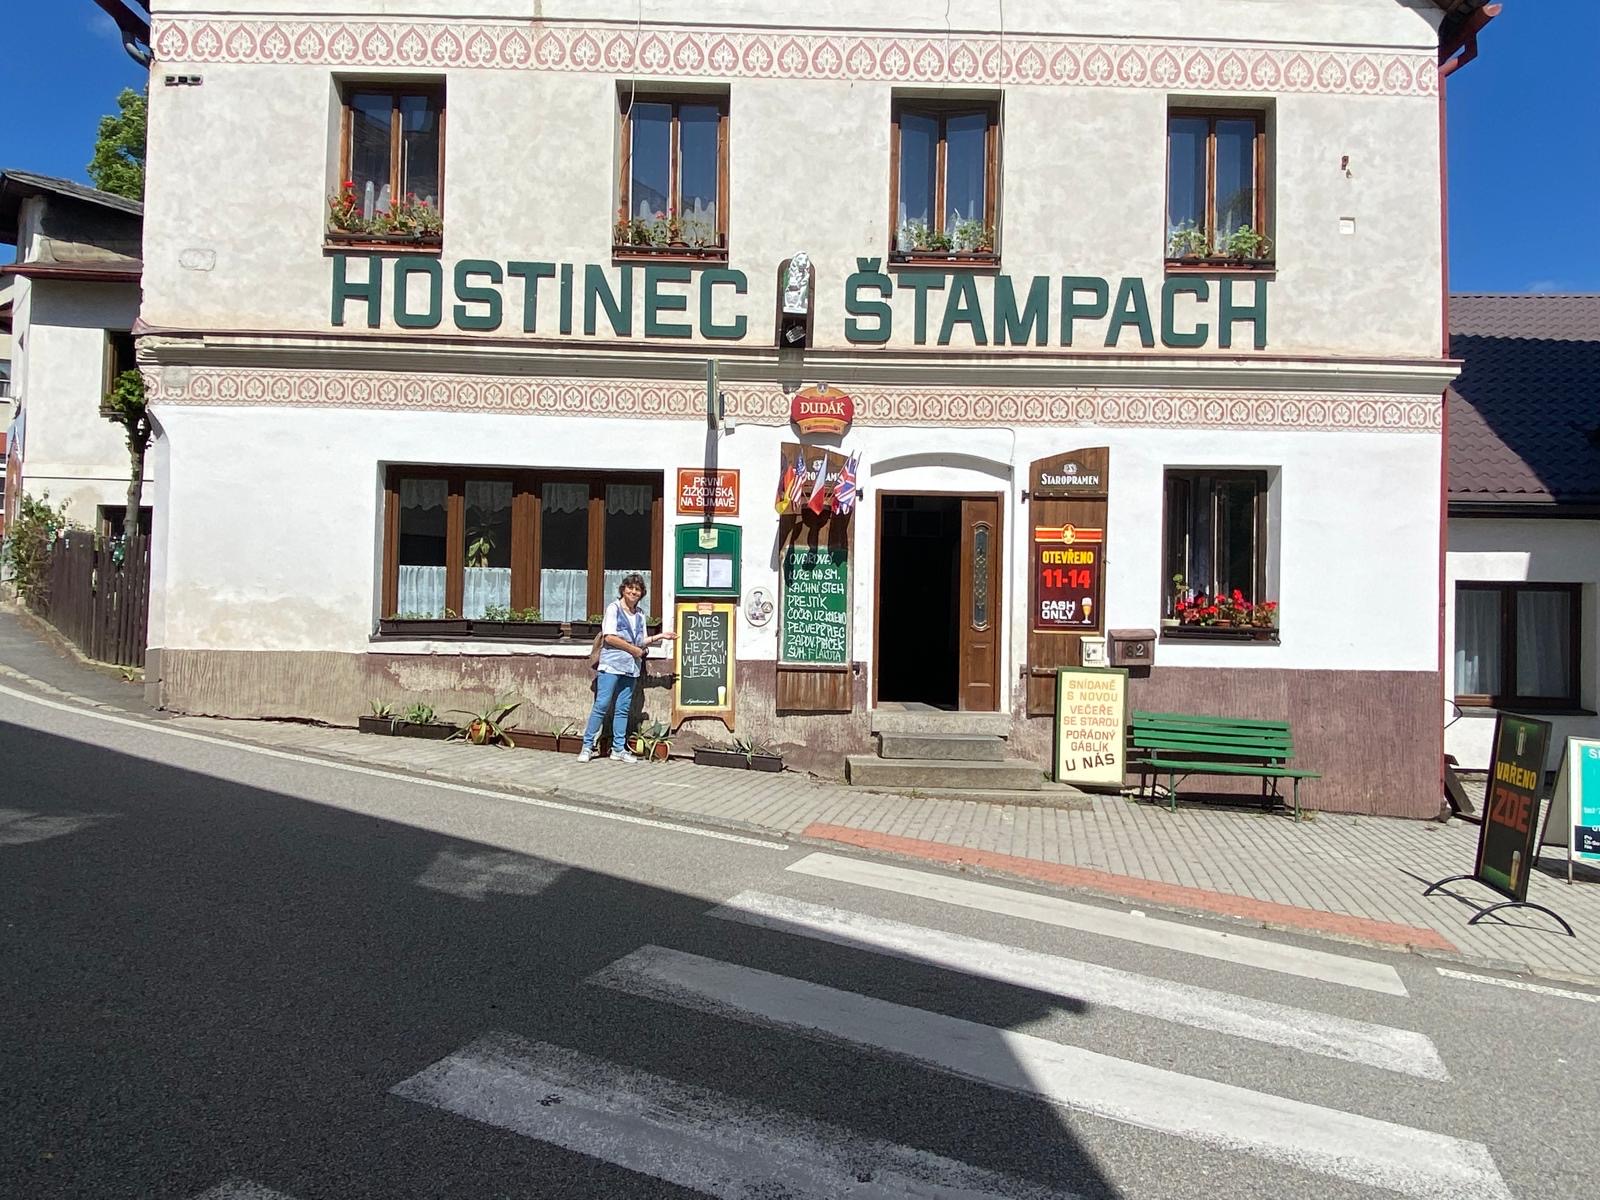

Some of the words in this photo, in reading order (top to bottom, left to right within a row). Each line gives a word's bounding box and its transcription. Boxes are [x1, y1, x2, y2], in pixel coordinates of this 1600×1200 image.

[331, 255, 748, 340] HOSTINEC
[844, 257, 1268, 349] ŠTAMPACH
[800, 401, 845, 416] DUDÁK
[693, 475, 724, 487] PRVNÍ
[1041, 473, 1099, 485] STAROPRAMEN
[683, 485, 734, 497] ŽIŽKOVSKÁ
[681, 497, 693, 506] NA
[696, 496, 735, 507] ŠUMAVĚ
[1042, 549, 1094, 564] OTEVŘENO
[1042, 569, 1091, 588] 11-14
[1042, 600, 1075, 610] CASH
[1042, 610, 1074, 619] ONLY
[687, 615, 720, 628] DNES
[688, 629, 719, 641] BUDE
[683, 666, 721, 679] JEŽKY
[1068, 679, 1116, 691] SNÍDANĚ
[1066, 691, 1074, 701] S
[1080, 691, 1118, 702] NOVOU
[1070, 704, 1113, 716] VEČEŘE
[1063, 717, 1077, 726] SE
[1080, 717, 1119, 727] STAROU
[1066, 729, 1116, 741] POŘÁDNÝ
[1071, 741, 1109, 752] GÁBLÍK
[1065, 758, 1076, 772] U
[1083, 753, 1115, 769] NÁS
[1496, 761, 1537, 790] VAŘENO
[1492, 787, 1532, 833] ZDE
